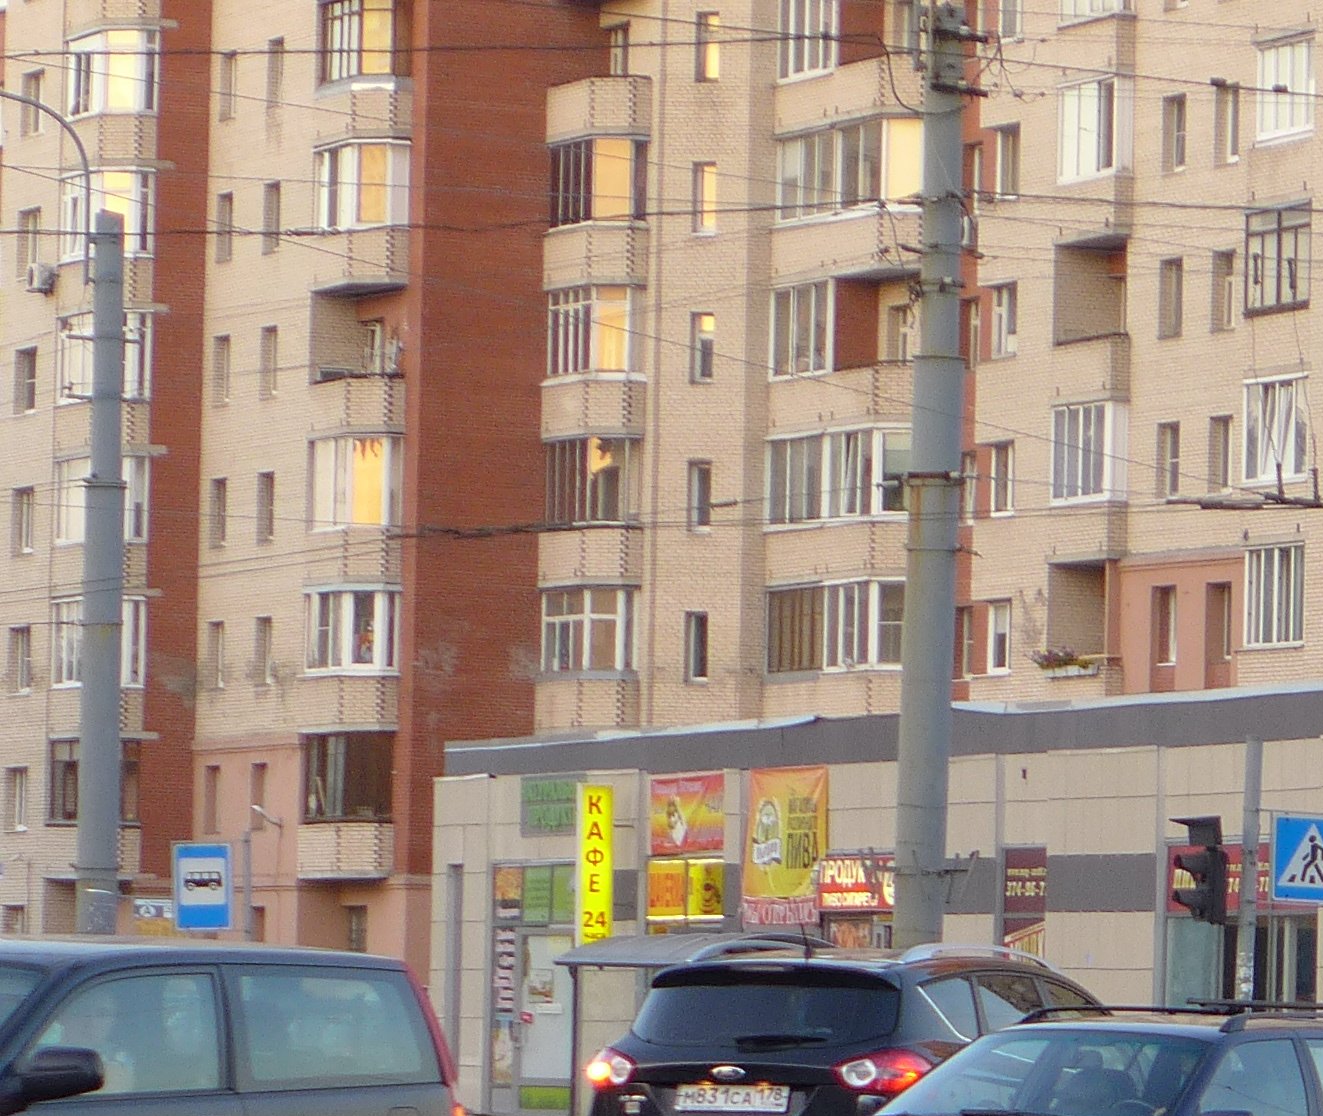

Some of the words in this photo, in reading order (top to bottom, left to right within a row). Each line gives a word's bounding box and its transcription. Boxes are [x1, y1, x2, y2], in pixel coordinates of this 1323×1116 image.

[585, 795, 605, 893] КАФЕ
[582, 911, 608, 928] 24
[756, 1088, 783, 1101] 178
